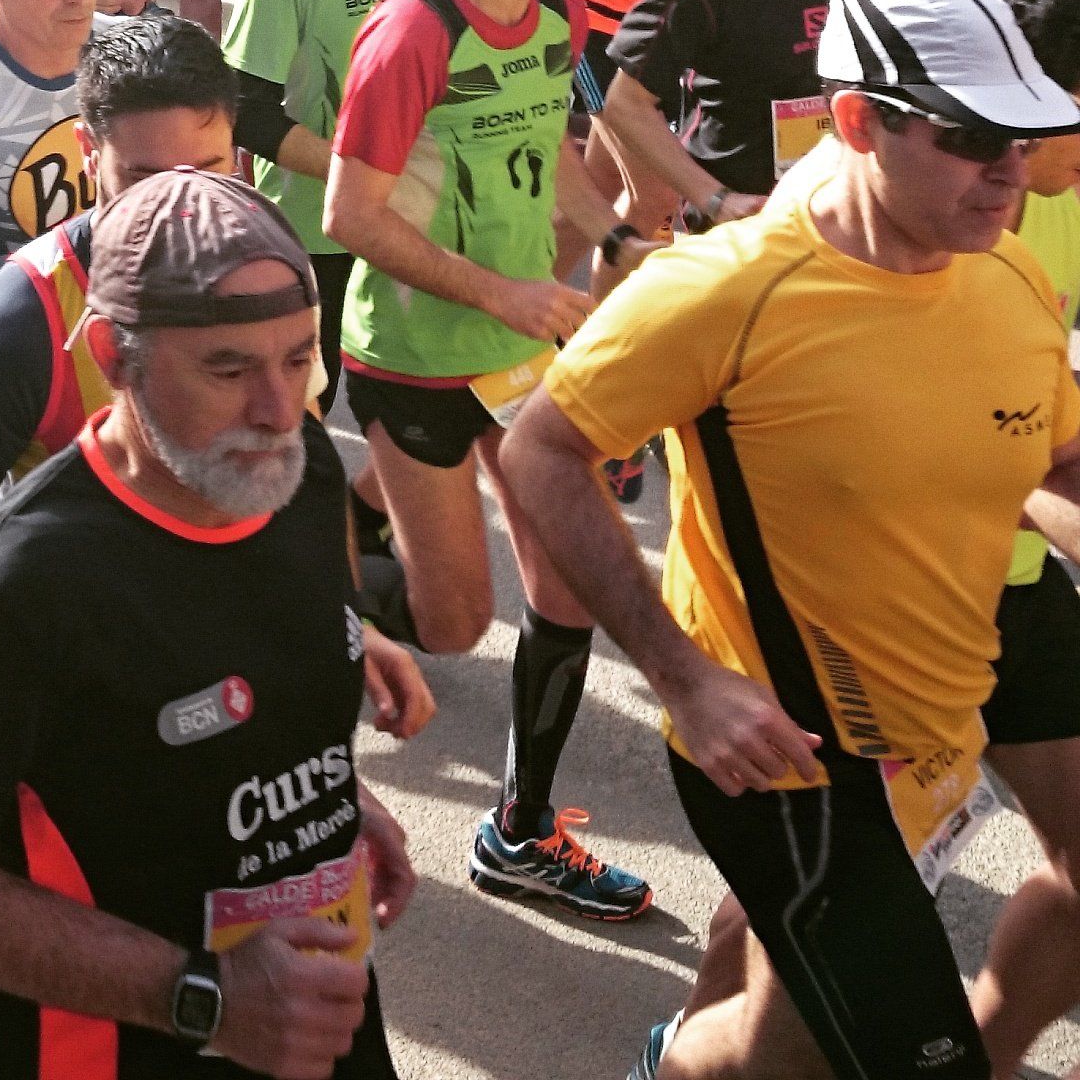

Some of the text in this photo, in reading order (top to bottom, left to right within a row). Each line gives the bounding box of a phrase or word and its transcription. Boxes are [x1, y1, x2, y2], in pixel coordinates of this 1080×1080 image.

[472, 108, 525, 130] BORN
[530, 103, 549, 119] TO
[176, 704, 219, 736] BCN
[226, 743, 352, 842] Curs
[265, 840, 293, 865] la
